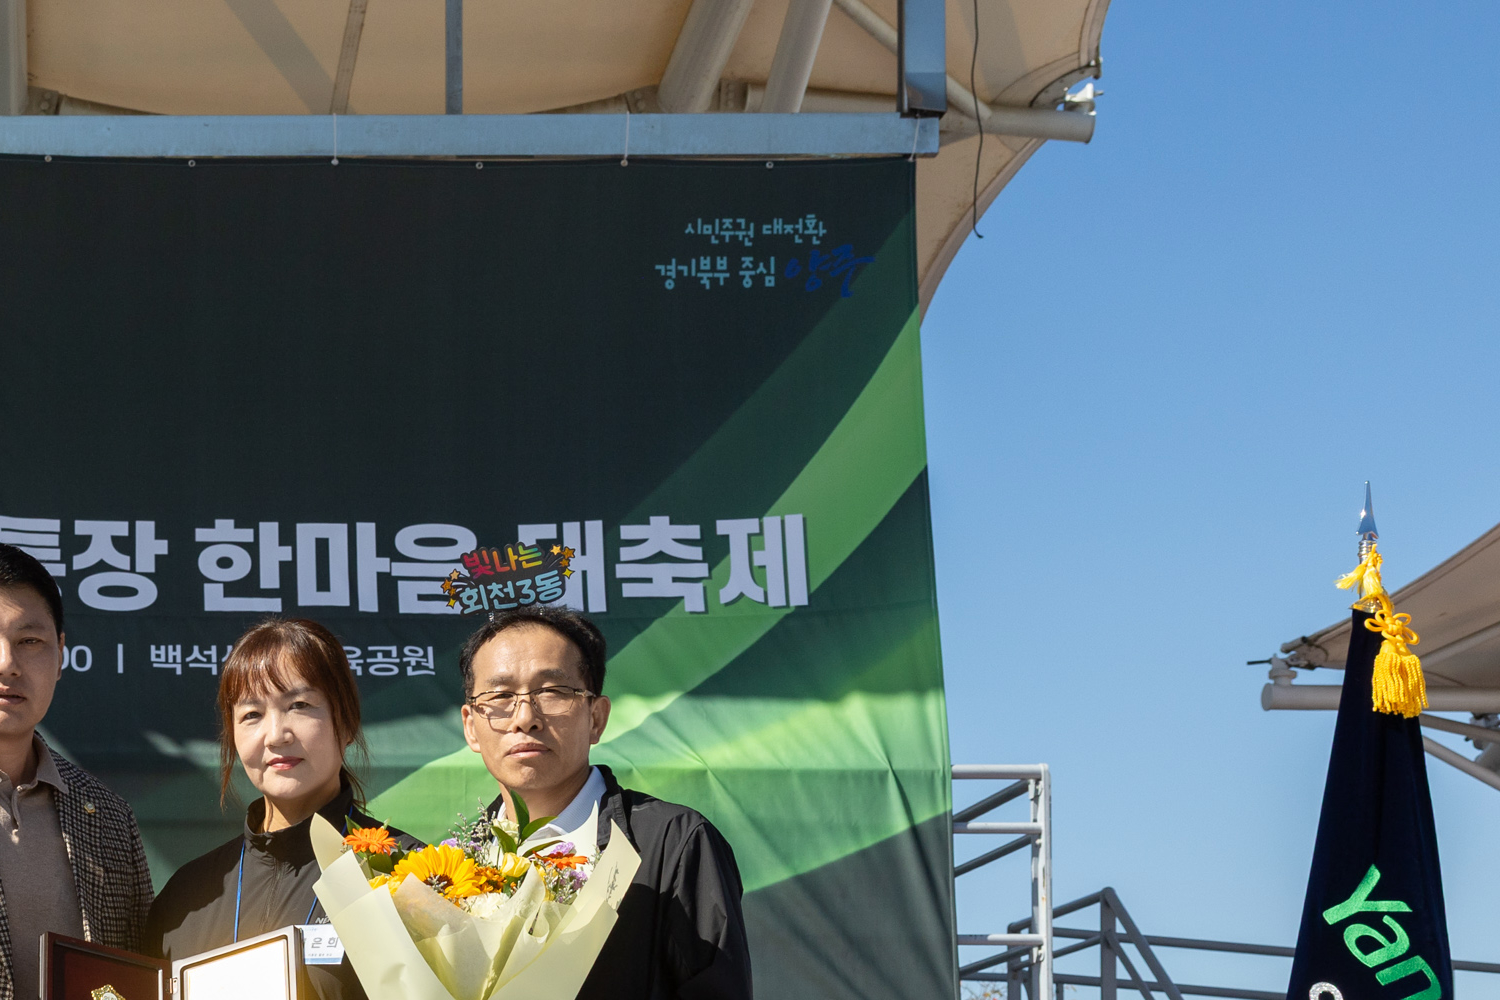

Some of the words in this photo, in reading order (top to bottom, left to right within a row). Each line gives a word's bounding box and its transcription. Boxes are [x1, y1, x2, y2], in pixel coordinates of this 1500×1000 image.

[684, 217, 755, 247] 시민주권
[762, 213, 828, 245] 대전환
[654, 256, 730, 290] 경기북부
[738, 255, 776, 288] 중심
[783, 243, 876, 299] 양주
[194, 518, 478, 616] 한마음
[463, 545, 543, 580] 빛나는
[459, 569, 564, 615] 회천3동
